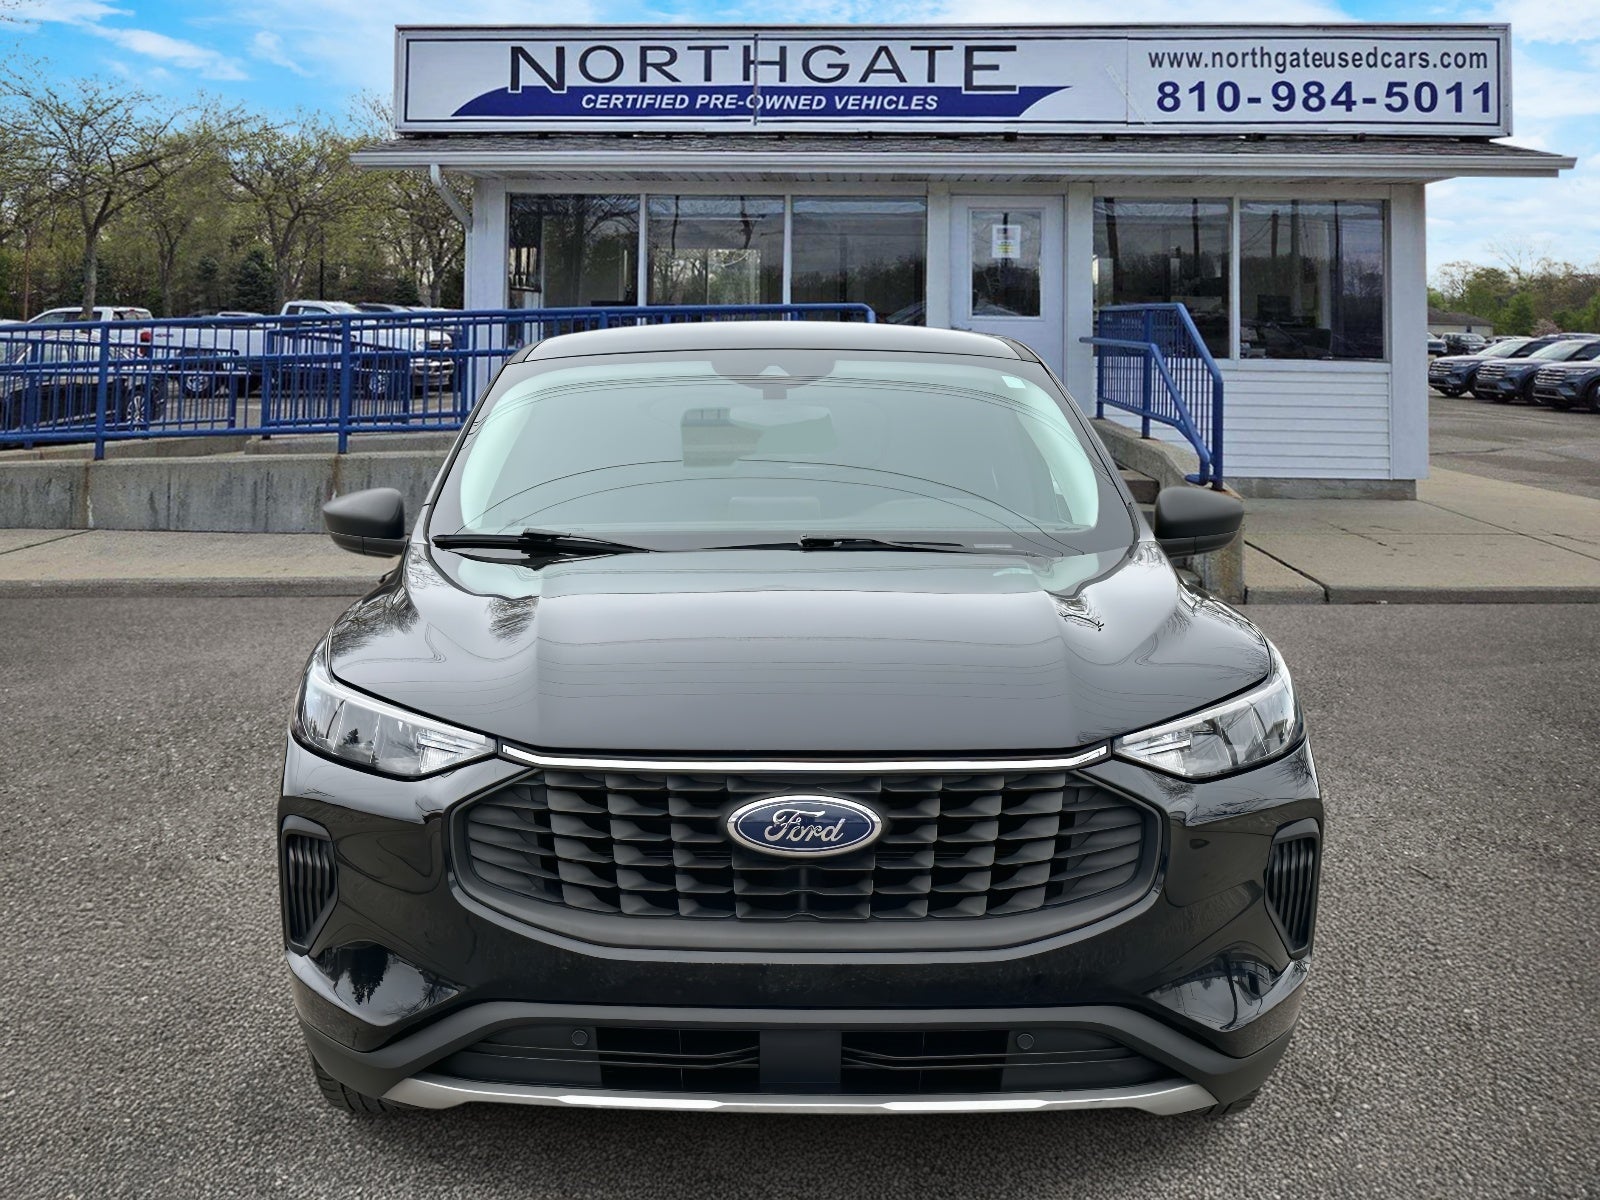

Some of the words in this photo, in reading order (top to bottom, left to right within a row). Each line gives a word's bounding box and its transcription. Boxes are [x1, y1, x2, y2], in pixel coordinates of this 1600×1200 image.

[510, 44, 1017, 92] NORTHGATE
[1148, 46, 1488, 73] www.northgateusedcars.com
[581, 93, 690, 110] CERTIFIED
[695, 94, 827, 111] PRE-OWNED
[834, 95, 939, 111] VEHICLES
[1156, 80, 1491, 114] 810-984-5011
[764, 808, 846, 842] Ford
